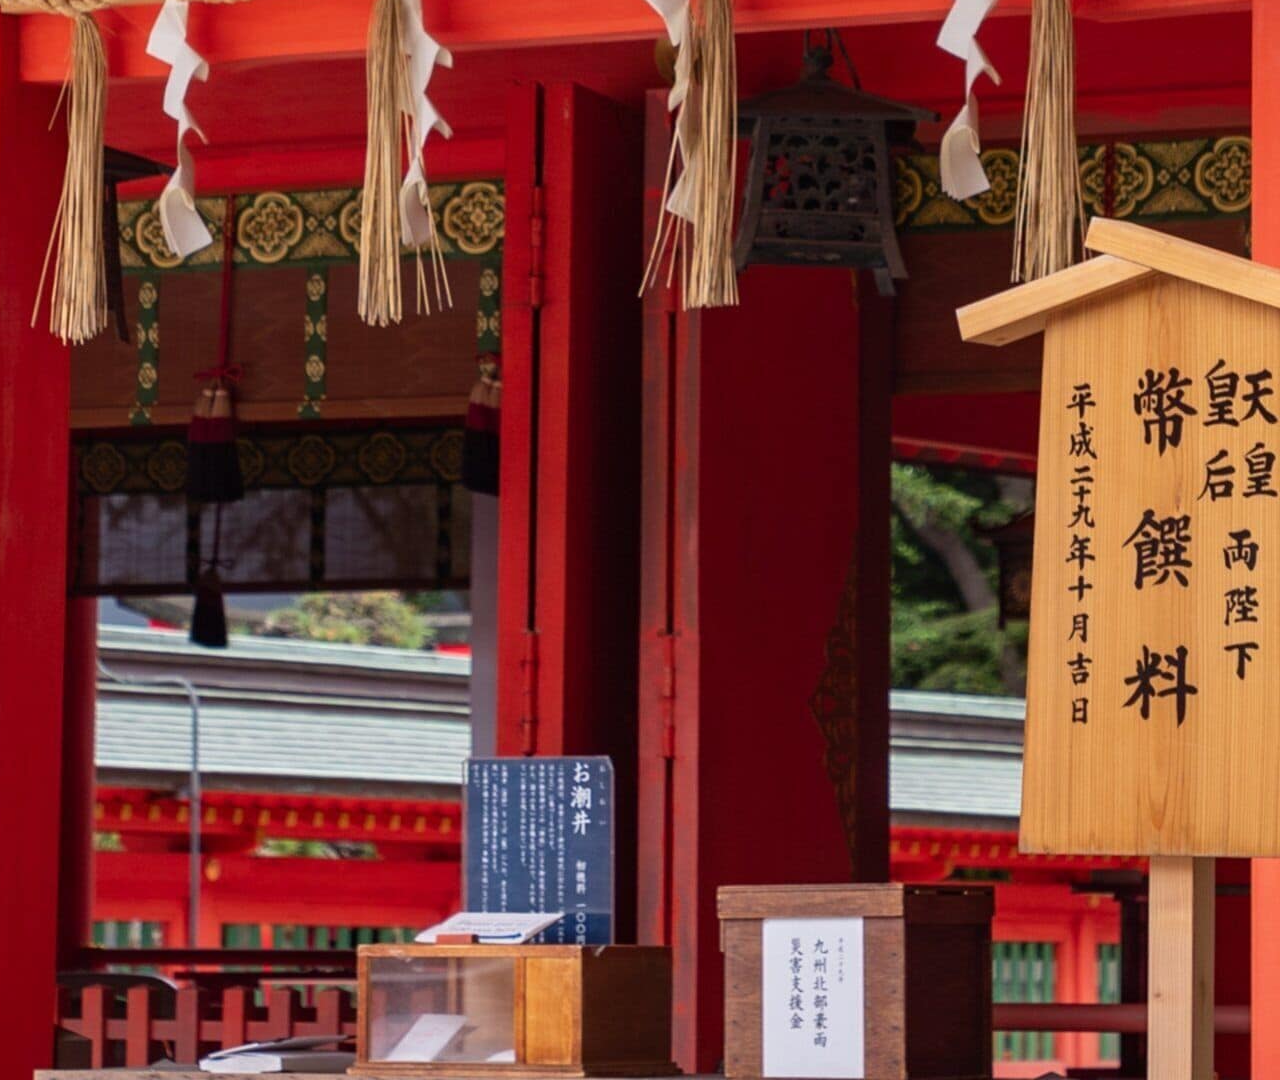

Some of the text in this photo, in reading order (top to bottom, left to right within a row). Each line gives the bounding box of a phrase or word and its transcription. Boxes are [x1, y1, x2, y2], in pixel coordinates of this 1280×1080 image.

[1194, 359, 1240, 502] 皇后
[1241, 368, 1278, 499] 天皇
[1065, 383, 1098, 724] 平成二十九年十月吉日
[1222, 529, 1260, 681] 両陛下
[570, 762, 592, 836] お潮井
[788, 937, 804, 1029] 災害支援金
[813, 938, 829, 1048] 九州北部豪雨
